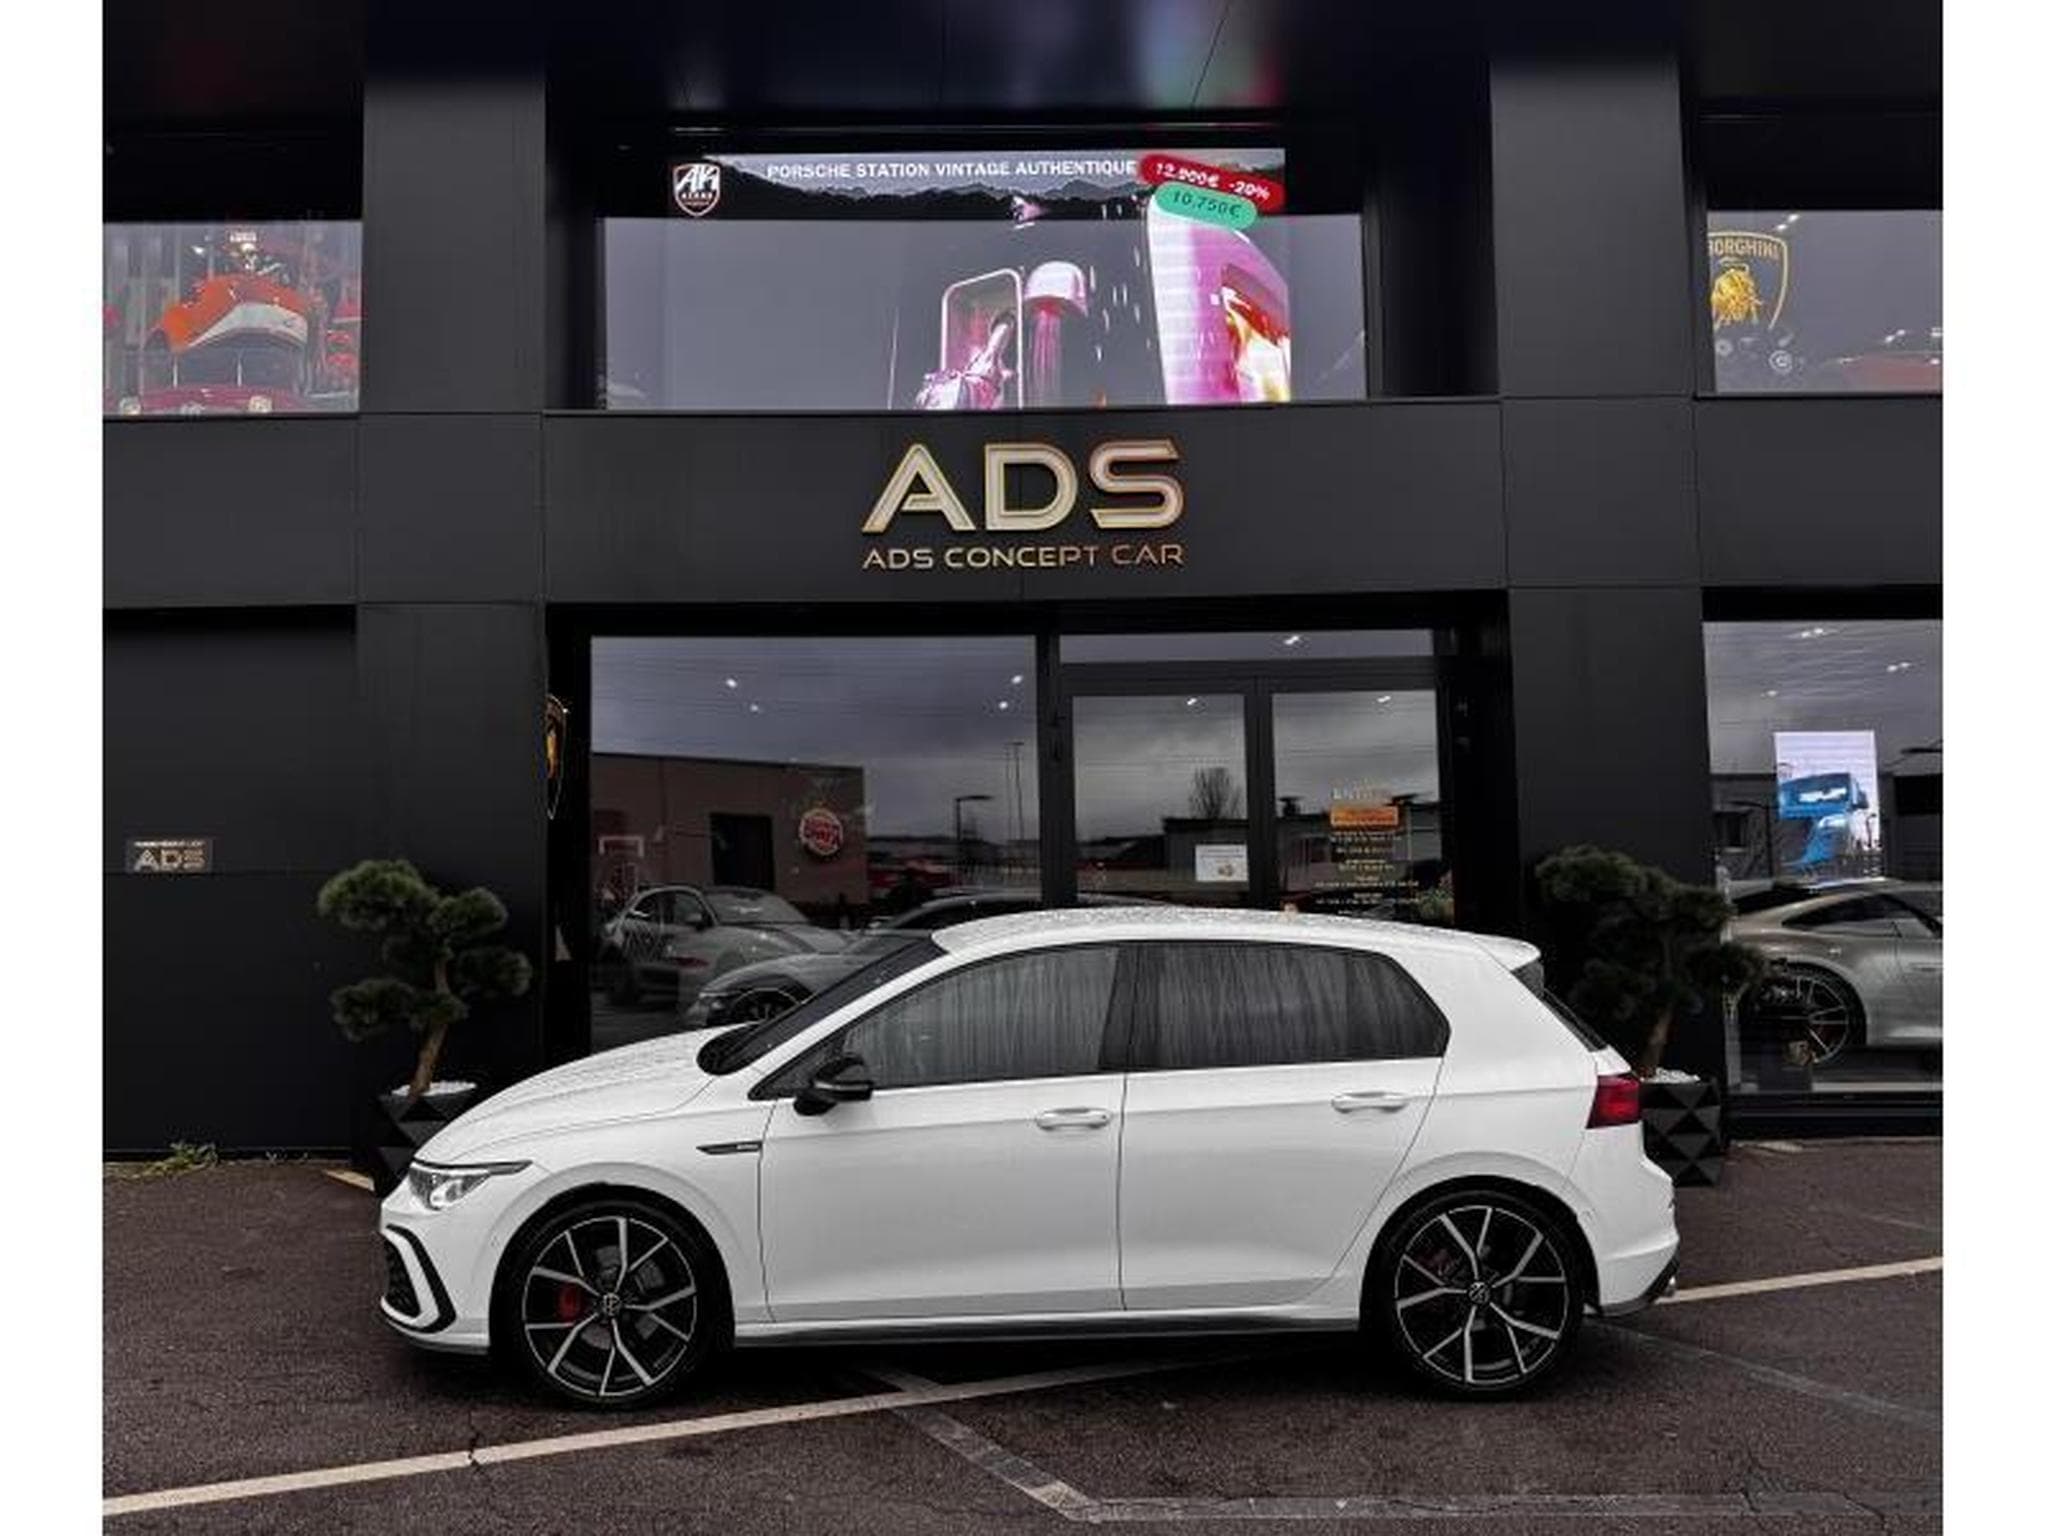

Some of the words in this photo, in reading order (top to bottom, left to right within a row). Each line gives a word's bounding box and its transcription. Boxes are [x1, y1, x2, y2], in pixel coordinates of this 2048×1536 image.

[767, 164, 850, 179] PORSCHE
[856, 162, 930, 178] STATION
[935, 161, 1011, 177] VINTAGE
[1015, 160, 1138, 176] AUTHENTIQUE
[862, 440, 1184, 533] ADS
[862, 549, 934, 570] ADS
[944, 546, 1099, 568] CONCEPT
[1111, 544, 1184, 565] CAR
[134, 849, 205, 872] ADS
